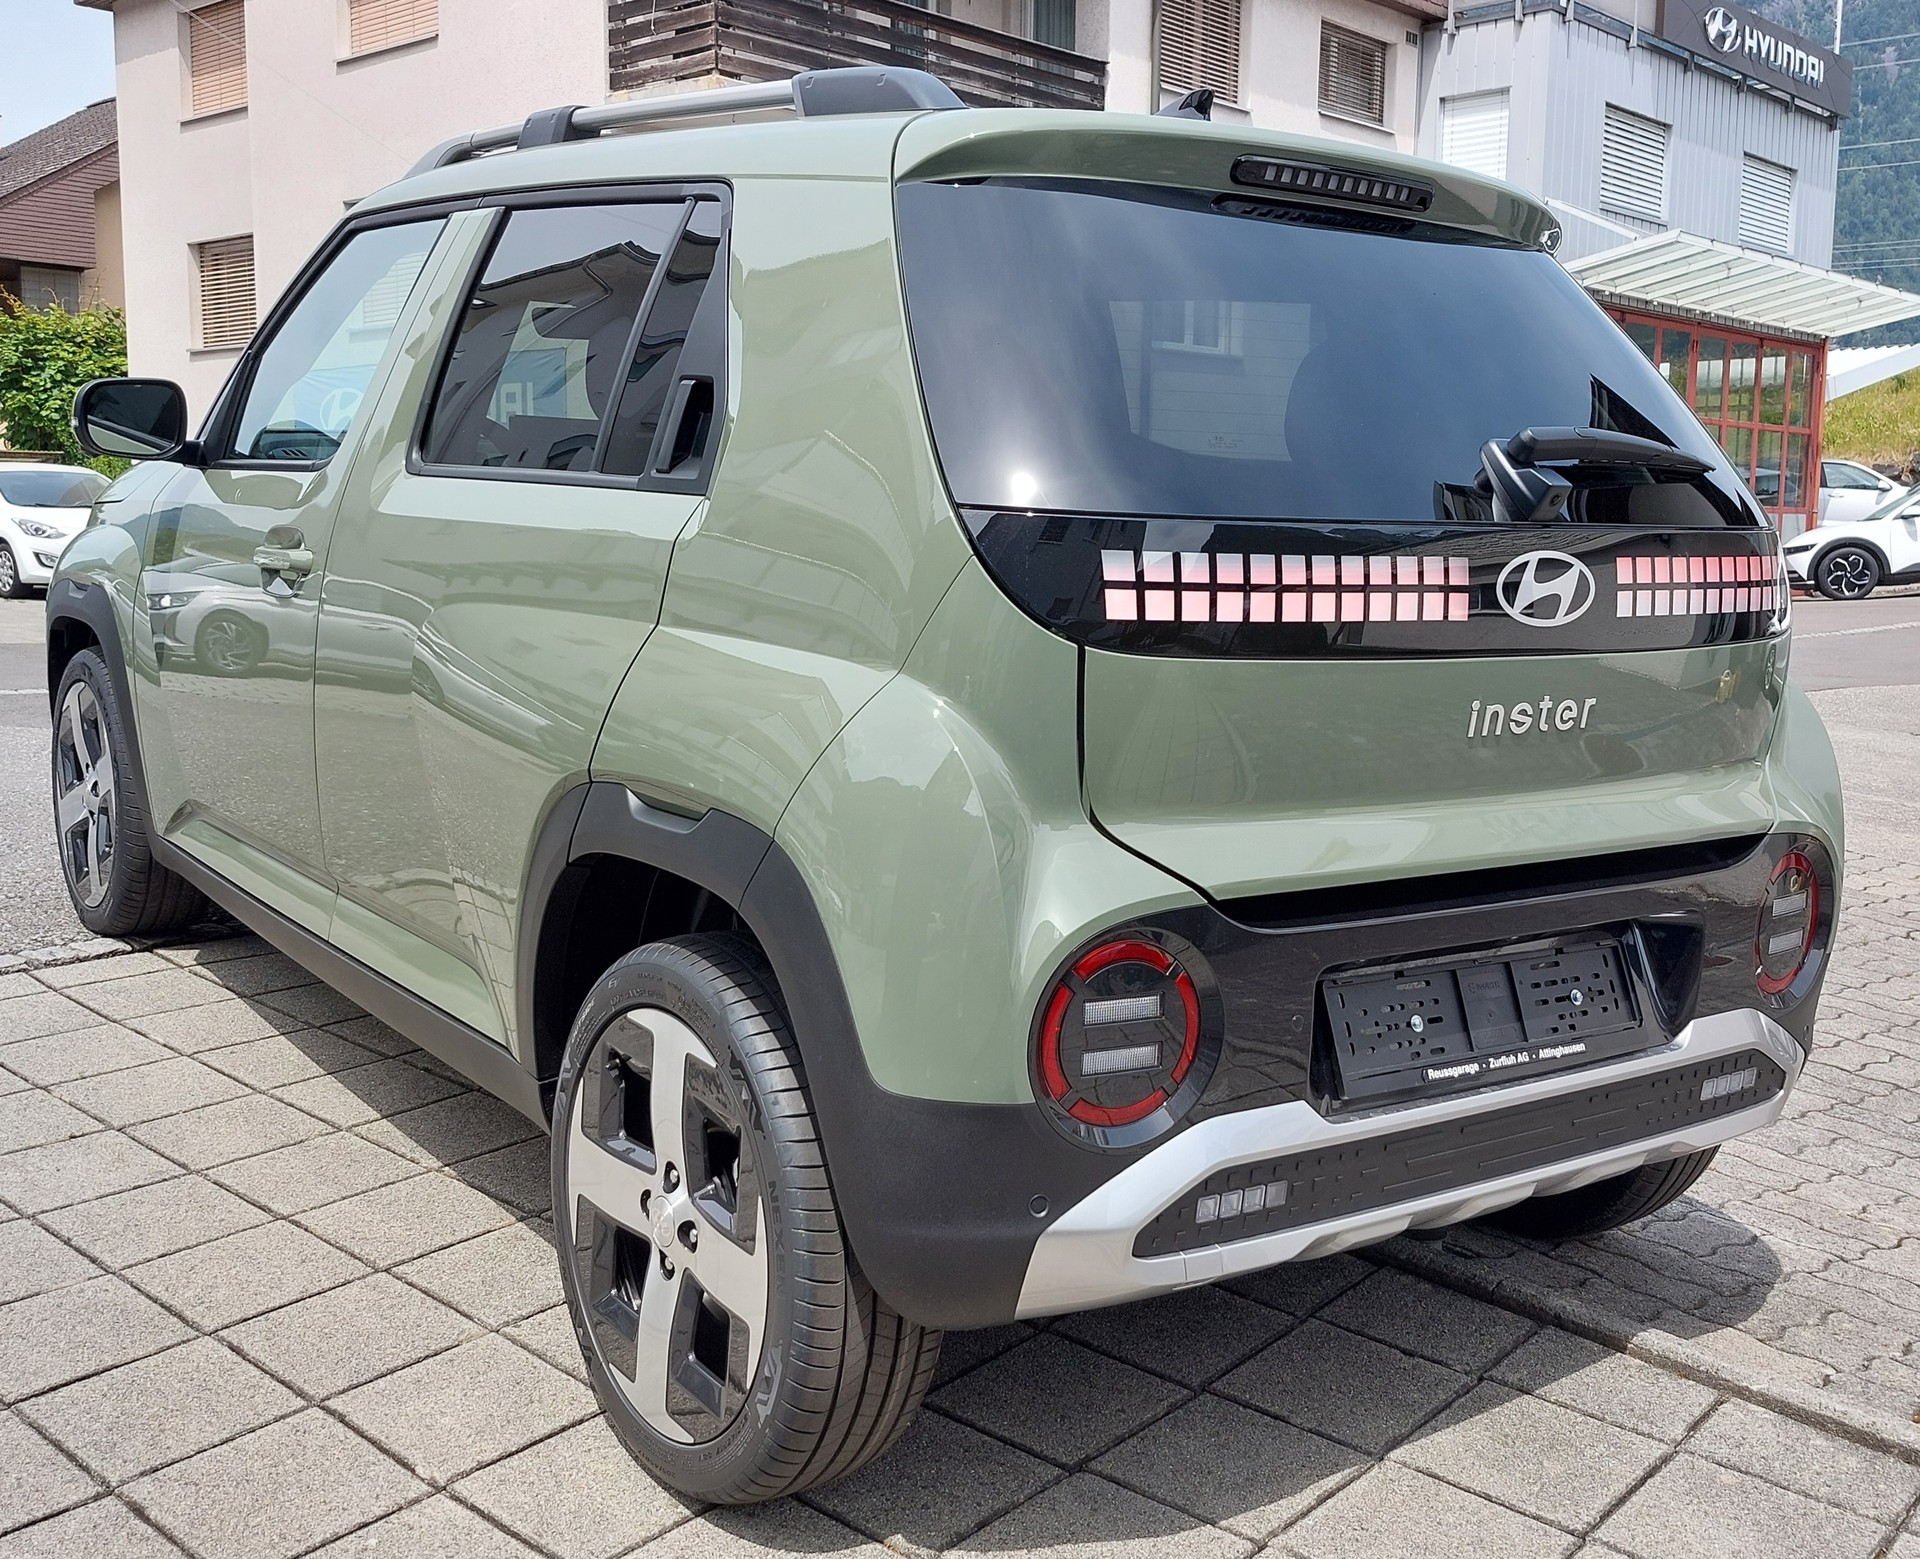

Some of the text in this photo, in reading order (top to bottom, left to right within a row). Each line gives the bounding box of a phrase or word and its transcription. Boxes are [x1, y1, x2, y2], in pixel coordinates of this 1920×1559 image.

[1744, 25, 1824, 83] HYUNDAI
[489, 382, 534, 422] AI
[1467, 695, 1597, 738] inster
[1427, 1043, 1586, 1080] Reussgarage Zurfluh AG Attinghausen
[767, 1180, 786, 1290] NEXEN
